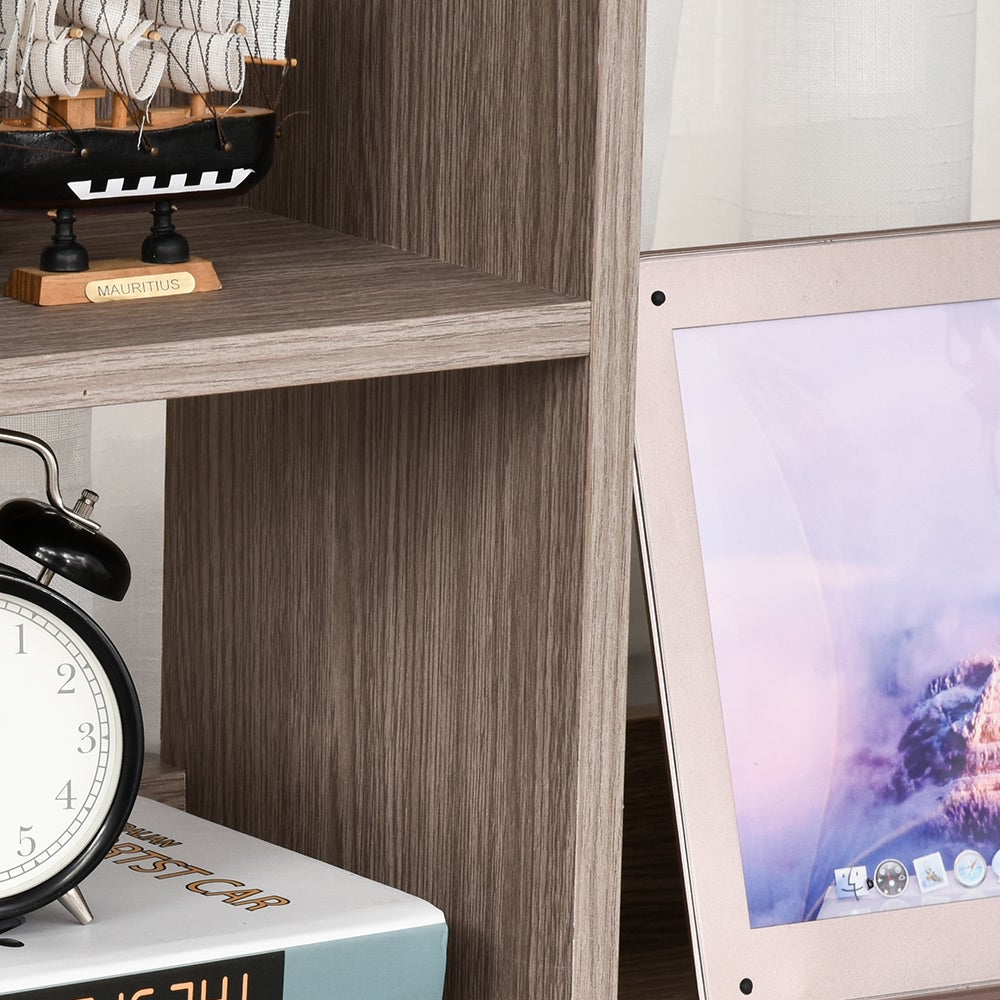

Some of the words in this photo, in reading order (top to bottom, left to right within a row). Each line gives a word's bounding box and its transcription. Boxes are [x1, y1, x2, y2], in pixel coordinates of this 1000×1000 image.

[98, 278, 181, 297] MAURITIUS
[15, 623, 28, 654] 1
[56, 663, 76, 694] 2
[77, 722, 96, 753] 3
[55, 778, 77, 810] 4
[17, 825, 36, 857] 5
[185, 878, 291, 911] CAR
